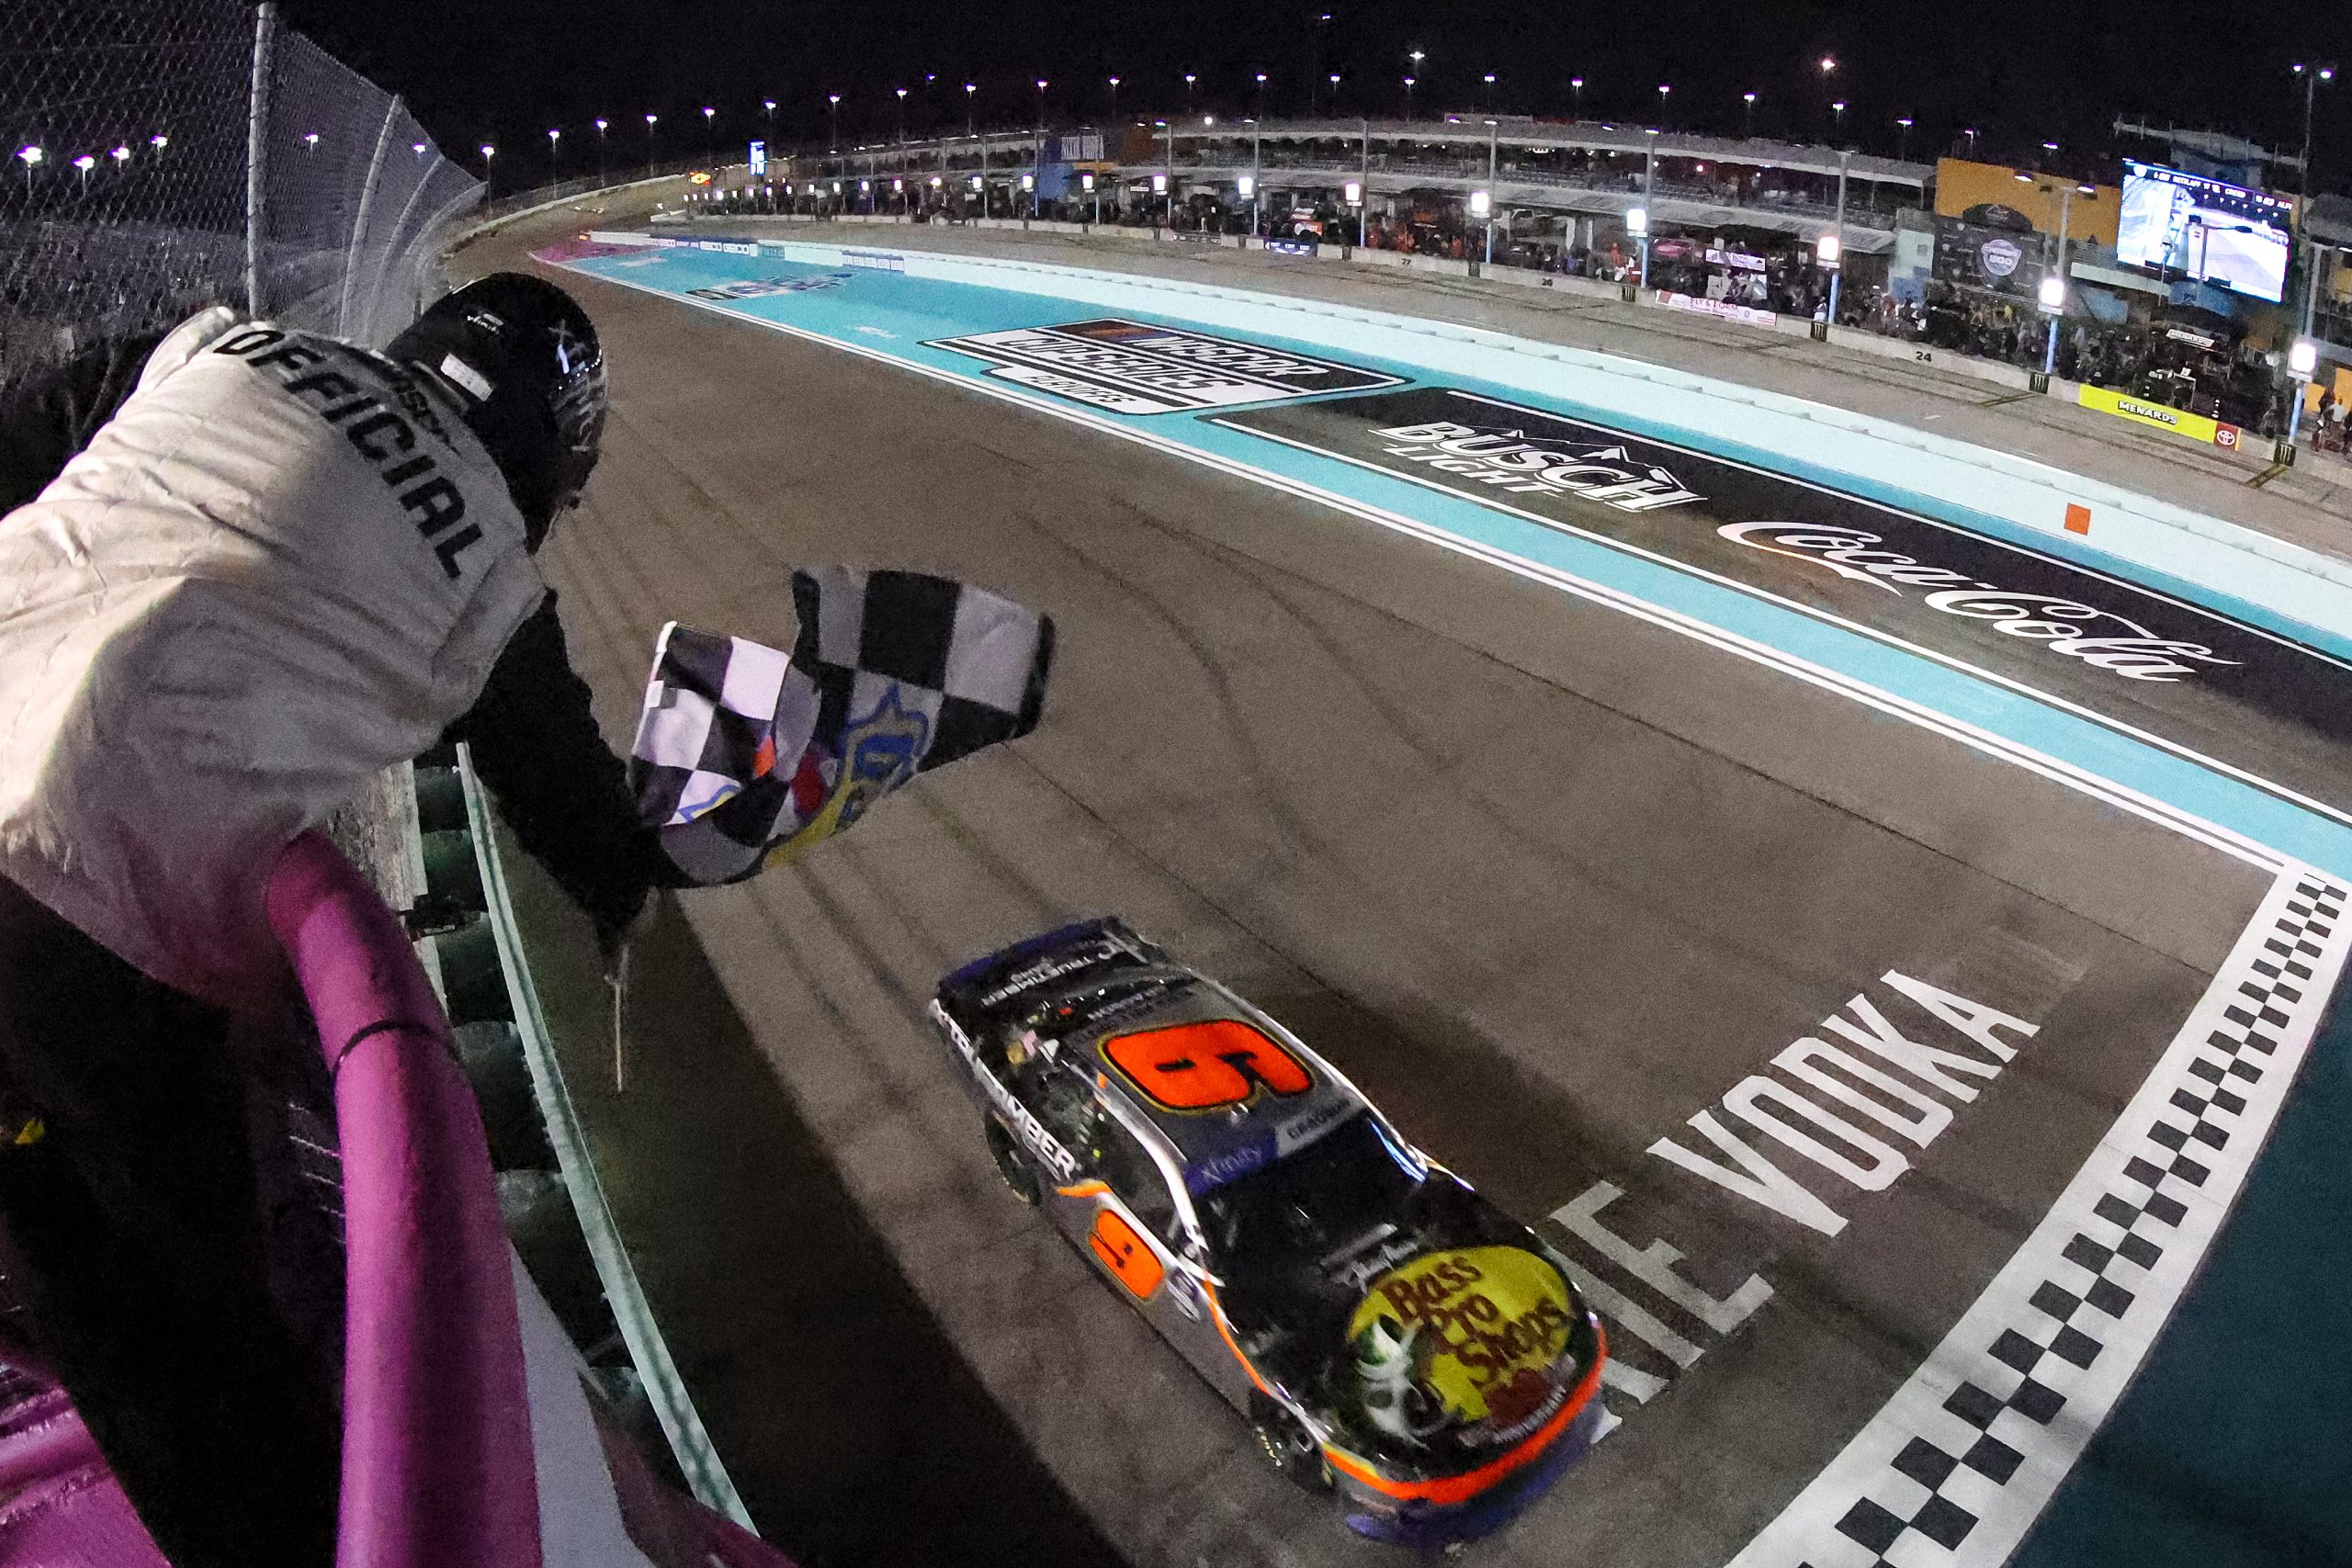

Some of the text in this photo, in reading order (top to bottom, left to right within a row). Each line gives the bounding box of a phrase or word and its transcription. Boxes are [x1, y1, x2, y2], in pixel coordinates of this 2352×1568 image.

[996, 338, 1244, 389] CUP SERIES
[1119, 336, 1329, 378] NASCAR
[1916, 350, 1933, 363] 24
[2118, 400, 2178, 425] MENARDS
[213, 329, 484, 579] OFFICIAL
[1368, 422, 1700, 512] BUSCH
[1384, 444, 1566, 497] LIGHT
[1717, 521, 2245, 682] Coca-Cola
[1099, 1017, 1315, 1111] 9
[1646, 969, 2041, 1237] VODKA
